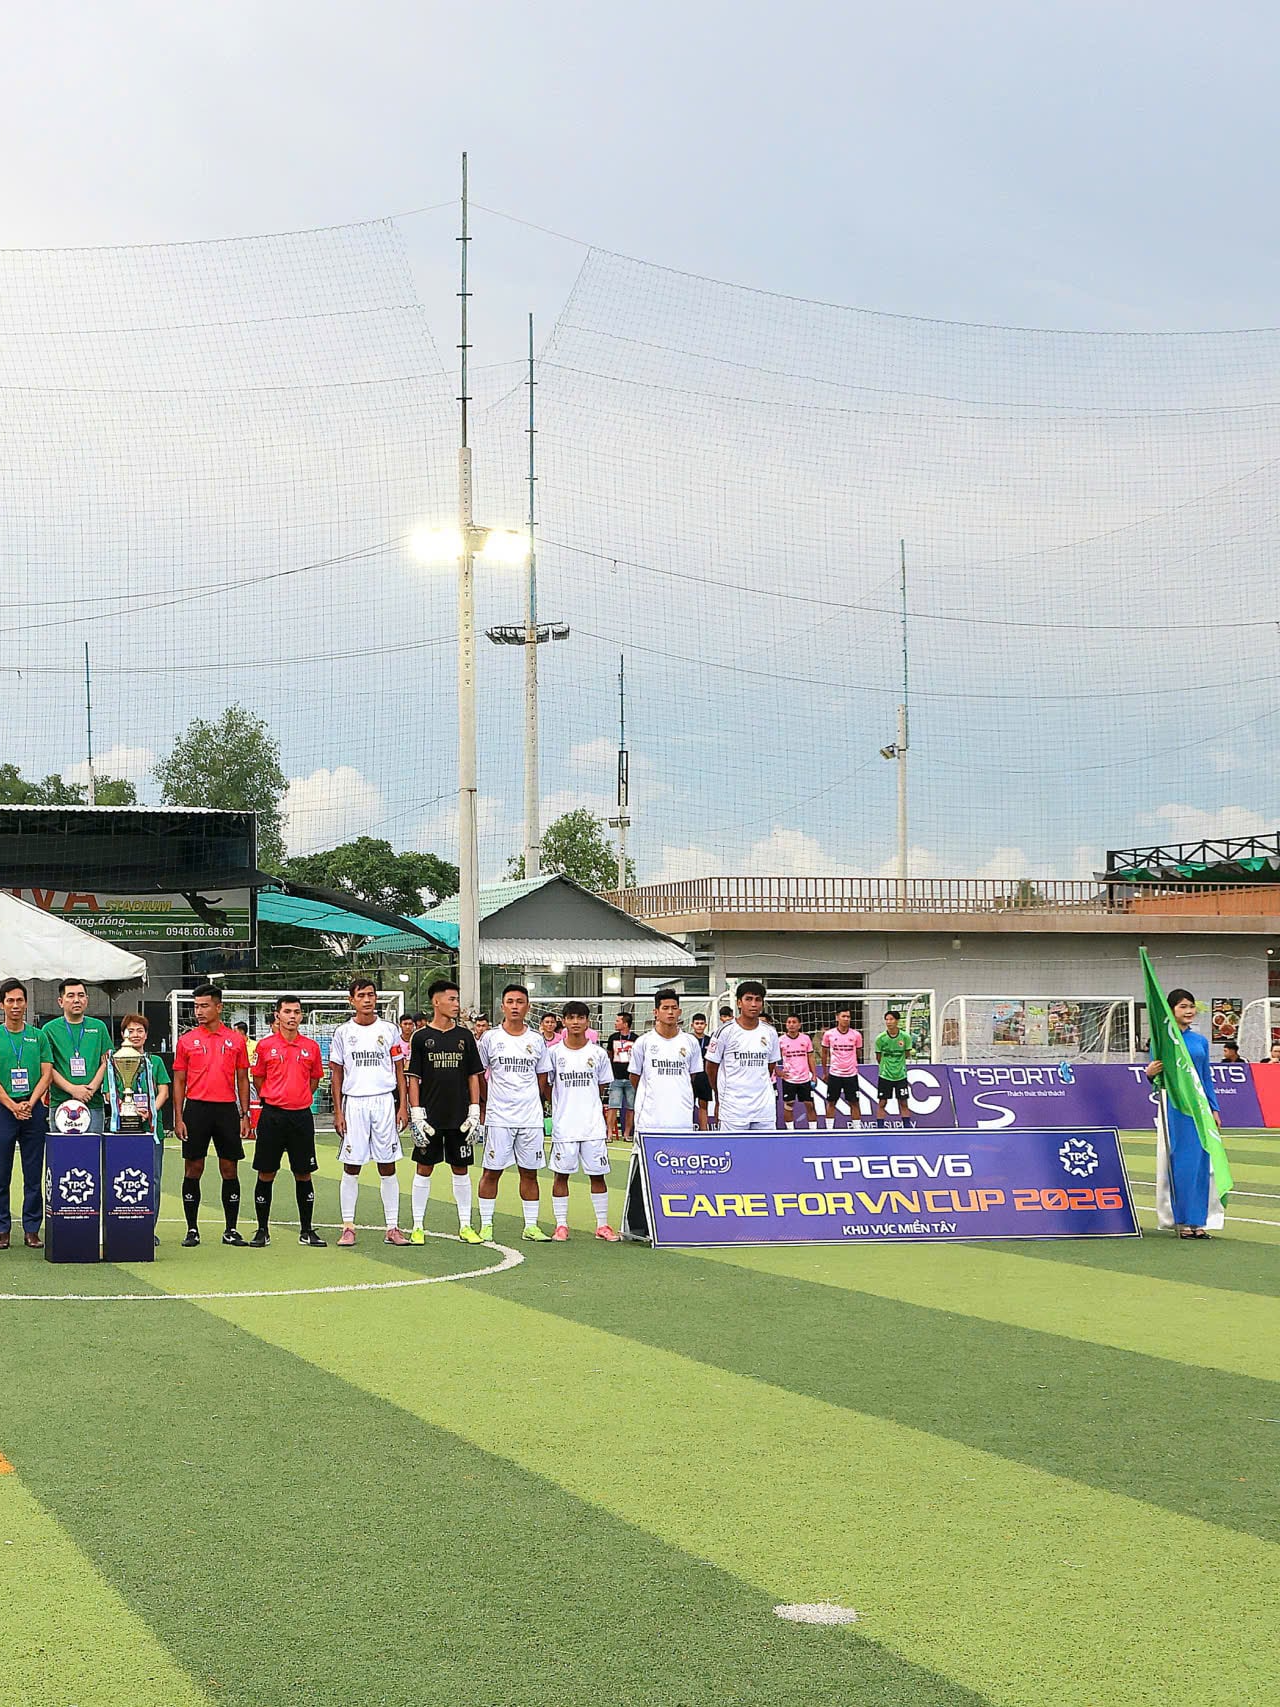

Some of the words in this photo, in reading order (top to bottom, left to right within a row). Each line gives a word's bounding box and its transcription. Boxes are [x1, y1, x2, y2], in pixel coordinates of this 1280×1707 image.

[105, 900, 173, 911] STADIUM
[166, 927, 235, 937] 0948.60.68.69
[352, 1051, 385, 1060] Emirates
[428, 1050, 463, 1061] Emirates
[498, 1056, 535, 1067] Emirates
[652, 1059, 686, 1069] Emirates
[559, 1070, 594, 1081] Emirates
[460, 1145, 472, 1158] 83
[1067, 1152, 1090, 1162] TPG
[655, 1152, 728, 1169] CareFor
[802, 1154, 973, 1180] TPG6V6
[67, 1181, 87, 1190] TPG
[122, 1181, 141, 1190] TPG
[660, 1192, 769, 1217] CARE
[772, 1191, 856, 1217] FOR
[855, 1190, 921, 1214] VN
[922, 1189, 1006, 1213] CUP
[1012, 1187, 1124, 1211] 2026
[842, 1224, 870, 1236] KHU
[870, 1223, 897, 1236] VỰC
[898, 1219, 931, 1234] MIỀN
[931, 1220, 957, 1233] TÂY
